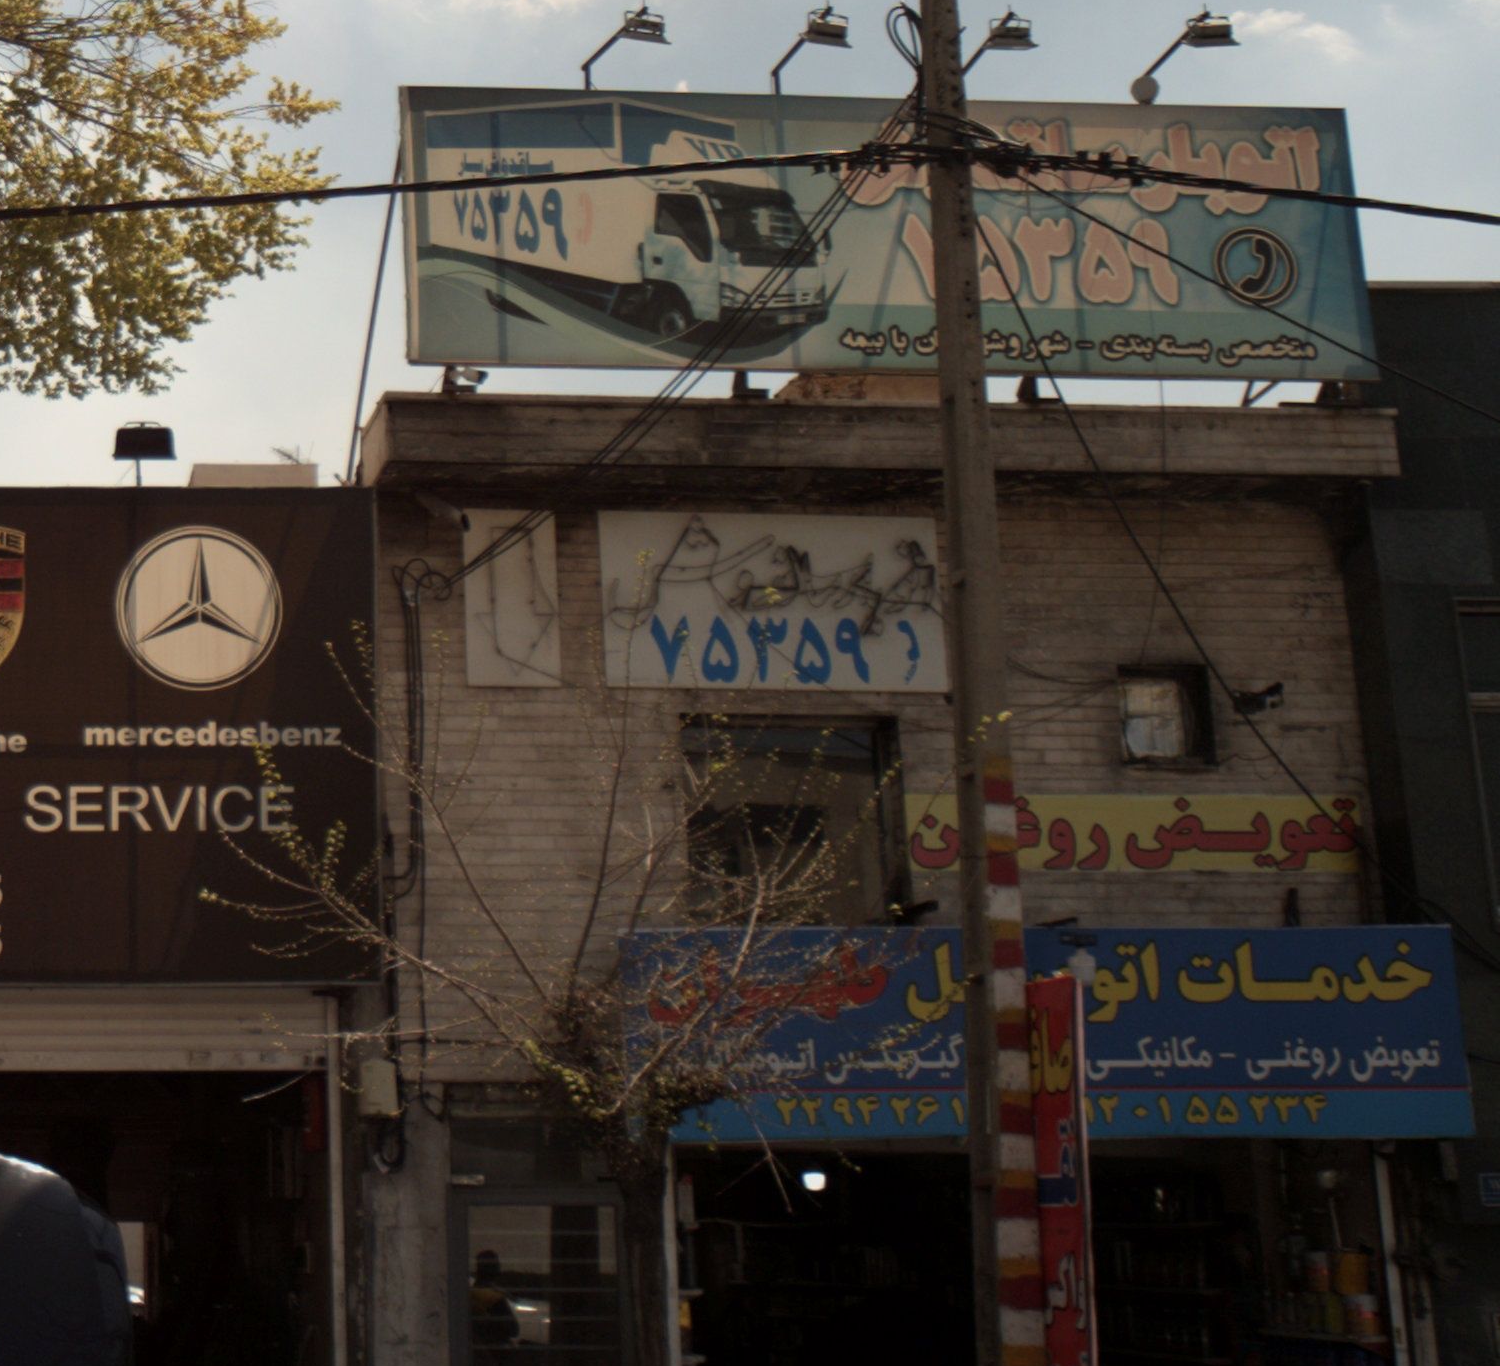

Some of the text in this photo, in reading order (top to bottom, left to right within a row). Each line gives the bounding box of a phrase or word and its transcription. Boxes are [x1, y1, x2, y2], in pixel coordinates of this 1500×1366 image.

[684, 135, 746, 161] VIP
[453, 187, 569, 262] ۷۵۳۵۹
[839, 326, 887, 357] بیمه
[888, 324, 910, 357] با
[1216, 335, 1318, 367] متخصص
[649, 613, 870, 684] ۷۵۳۵۹
[83, 722, 342, 749] mercedesbenz
[24, 785, 295, 834] SERVICE
[1125, 796, 1359, 871] تعویض
[904, 939, 1162, 1024] اتول
[1176, 940, 1435, 1004] خدمات
[1085, 1036, 1215, 1082] مکانیکی
[1244, 1037, 1341, 1082] روغنی
[1347, 1037, 1443, 1083] تعویض
[775, 1094, 967, 1128] ۲۲۹۴۲۶۱
